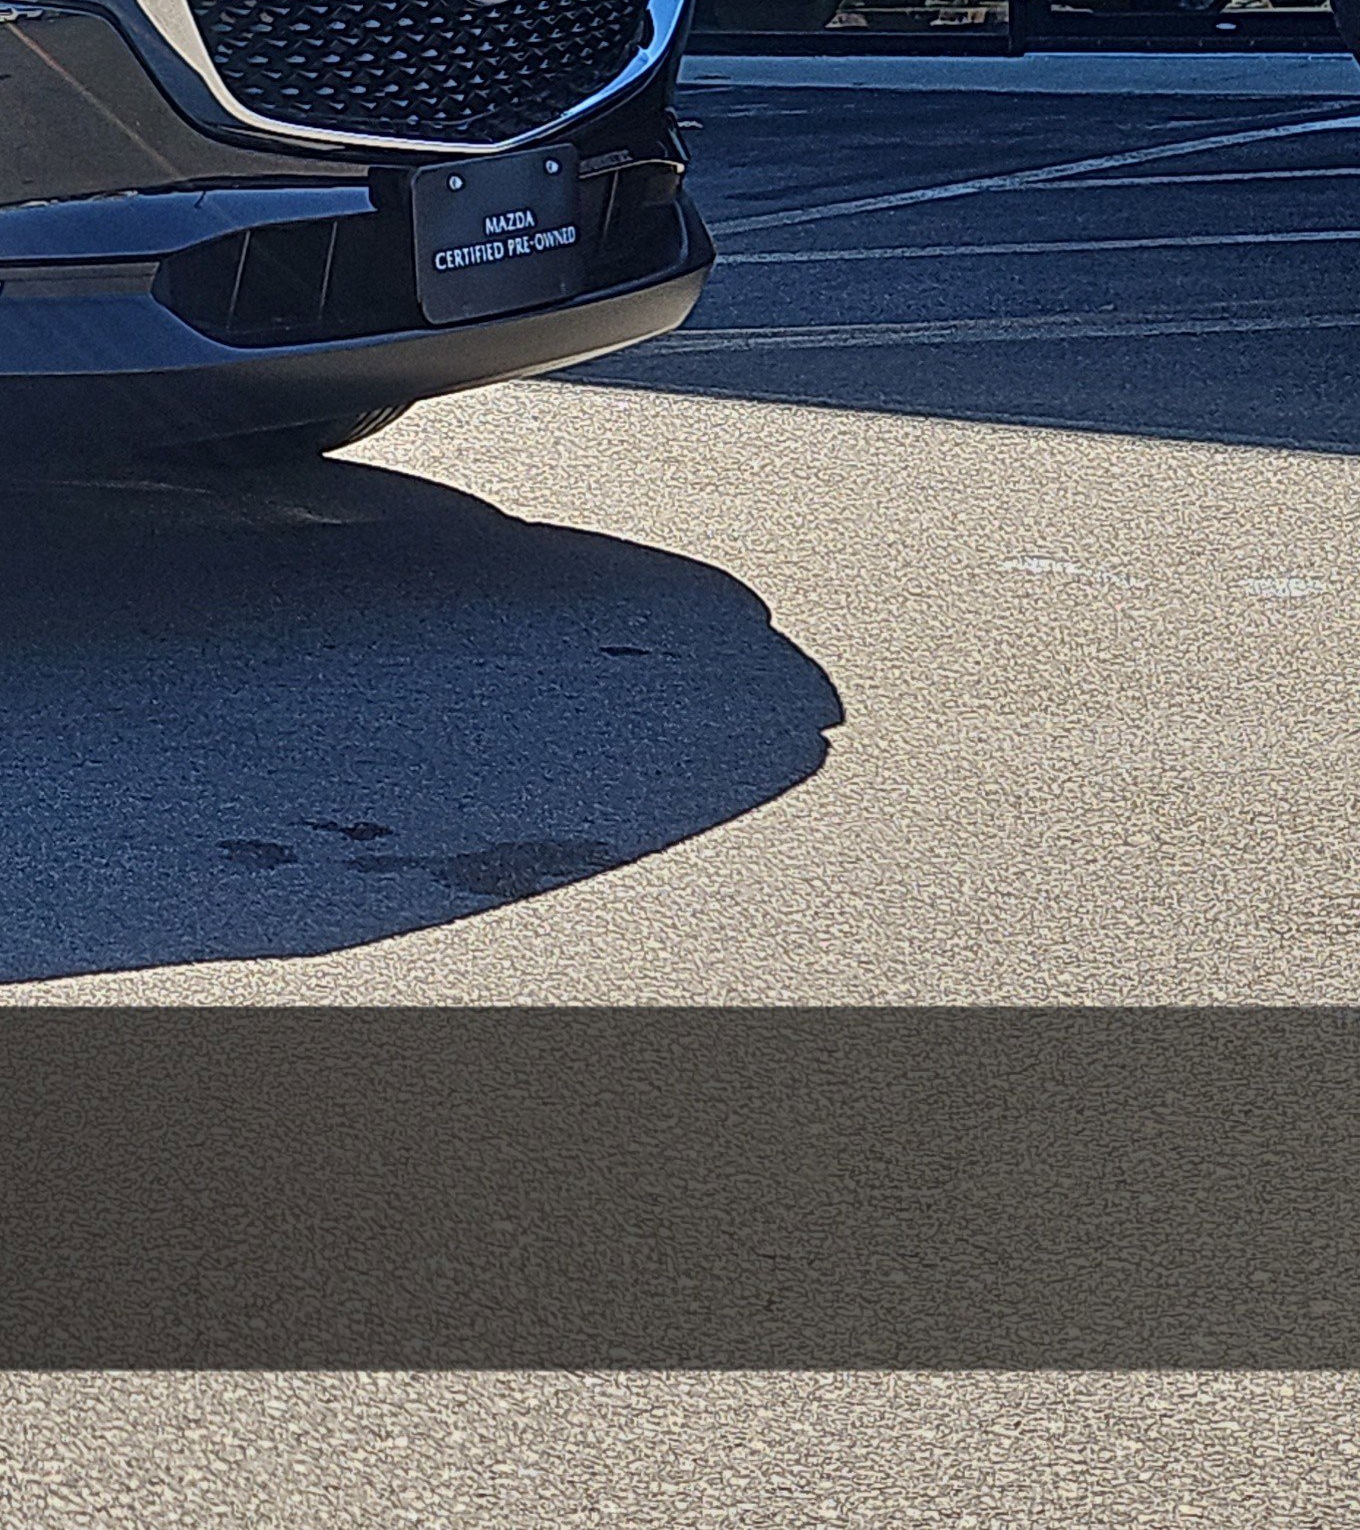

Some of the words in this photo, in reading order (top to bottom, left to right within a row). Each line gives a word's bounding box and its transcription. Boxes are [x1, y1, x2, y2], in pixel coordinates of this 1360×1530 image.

[485, 210, 535, 235] MAZDA
[435, 242, 505, 270] CERTIFIED
[507, 226, 577, 257] PRE-OWNED
